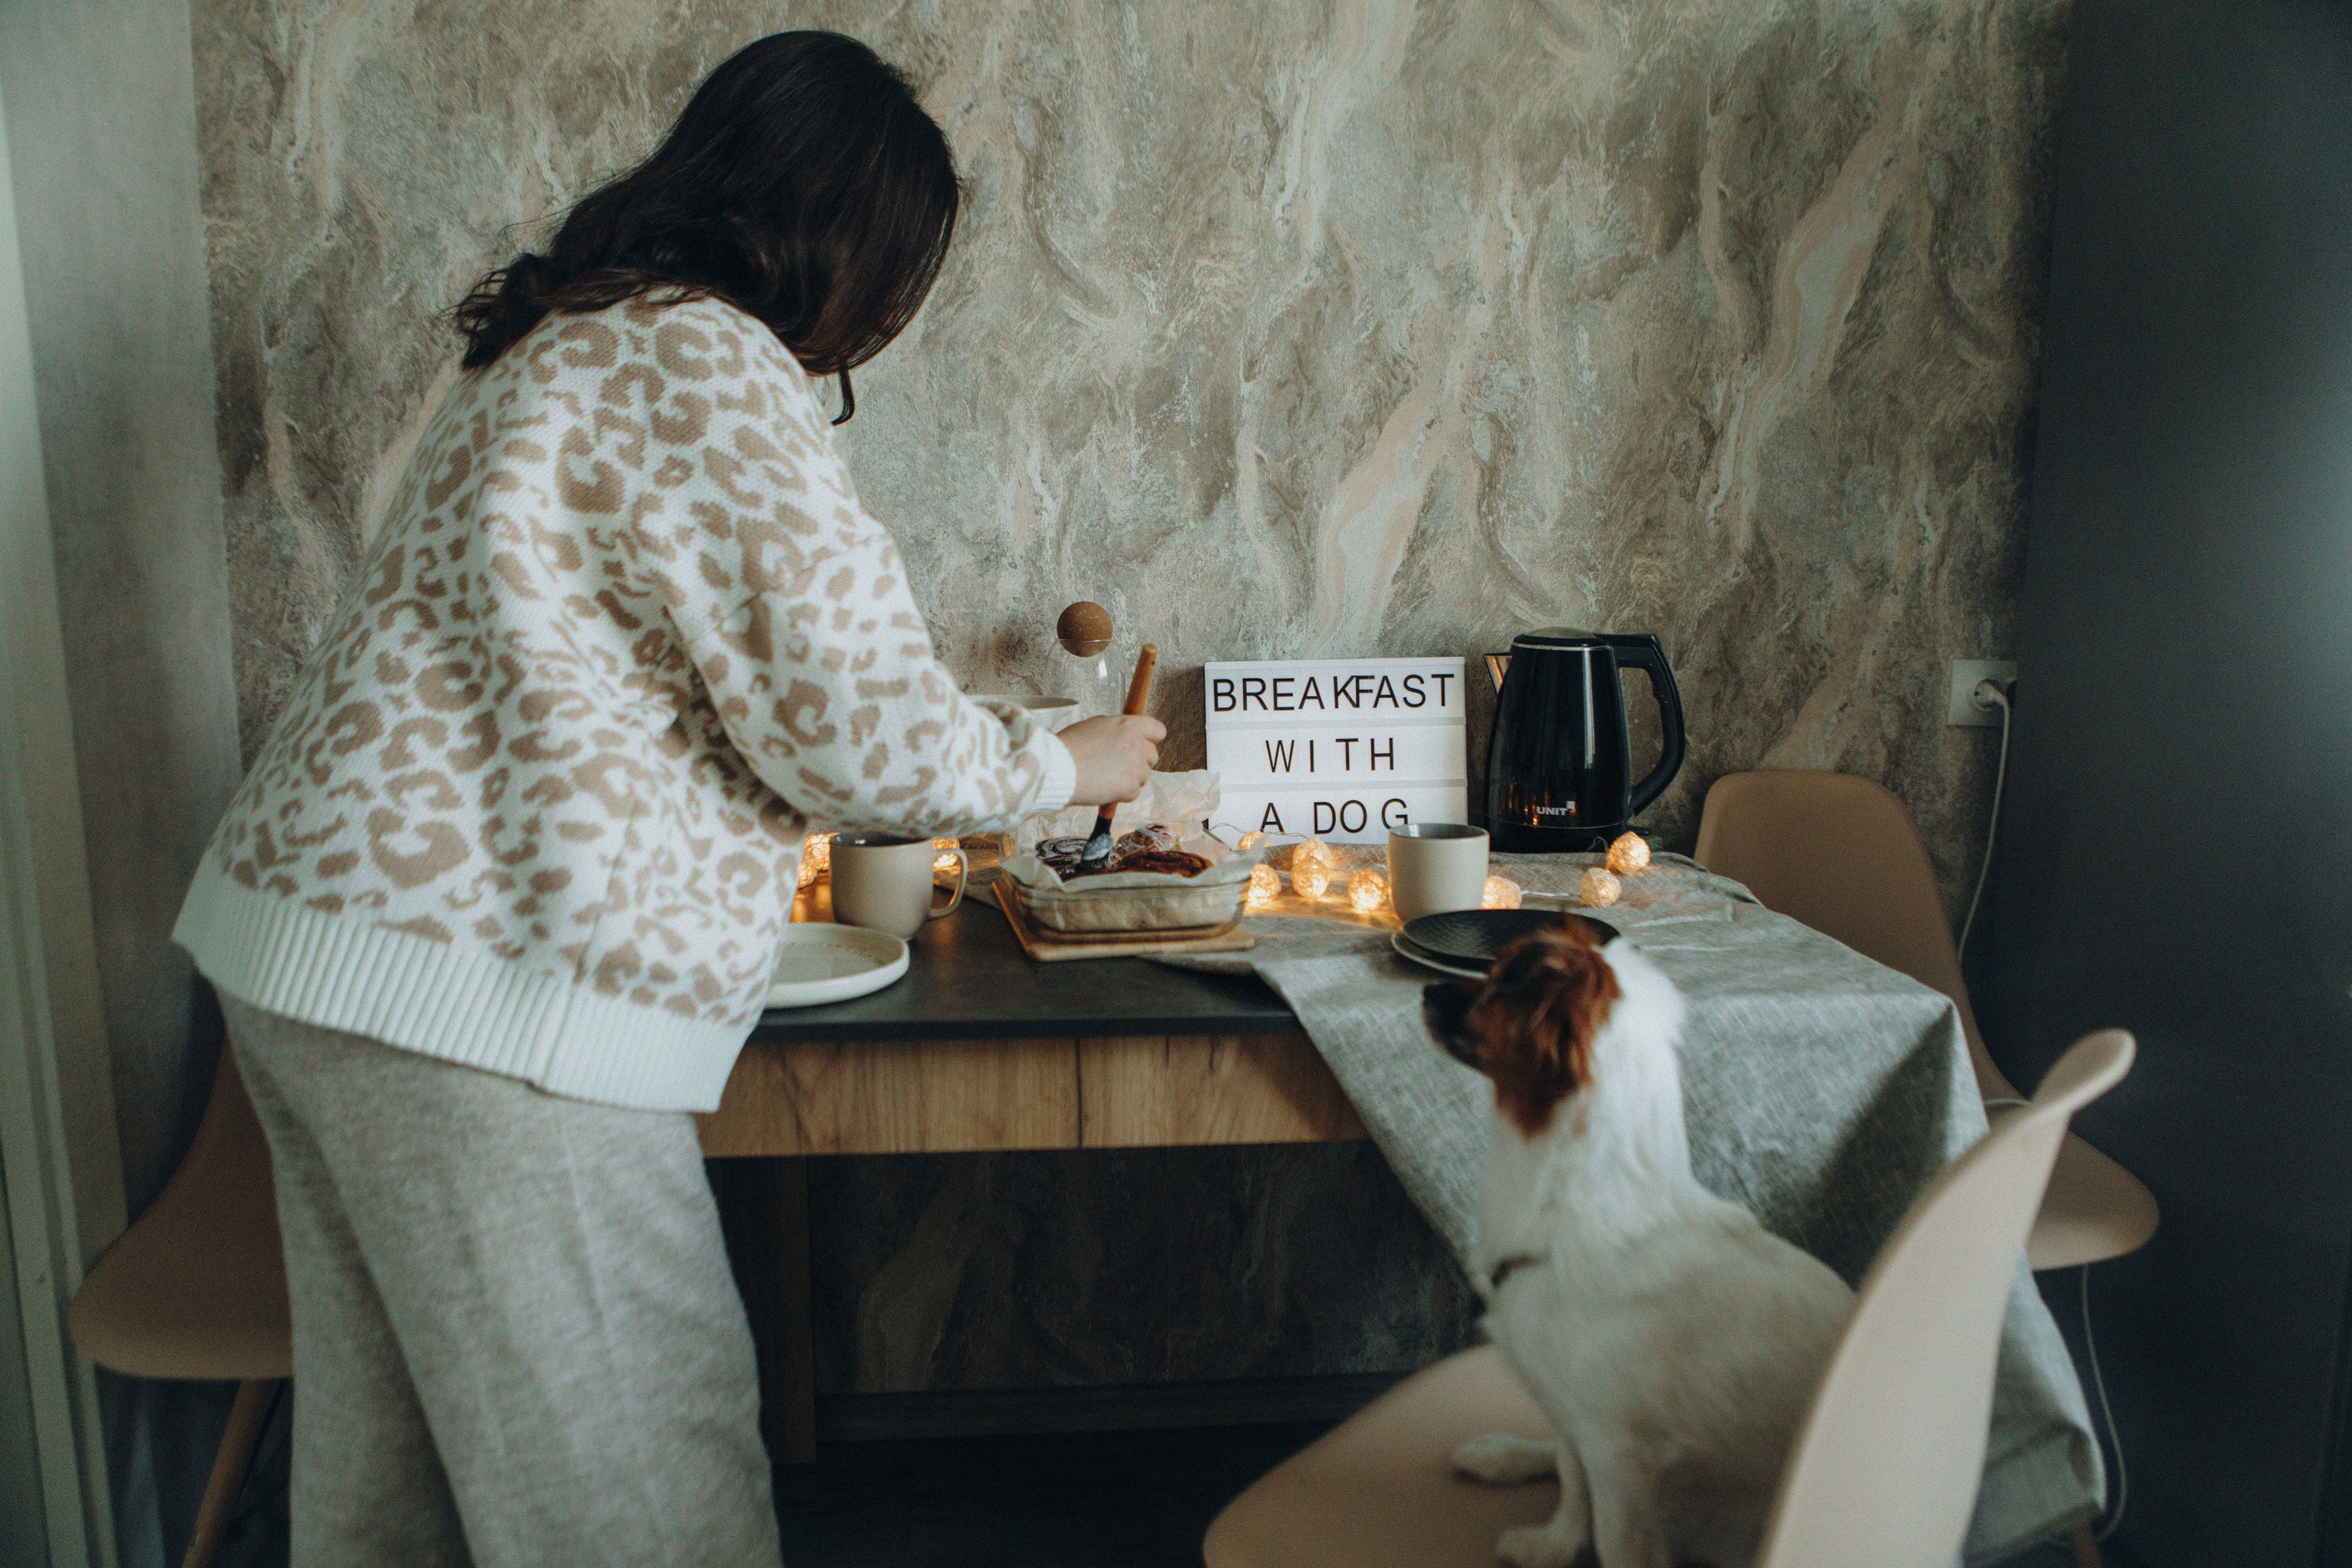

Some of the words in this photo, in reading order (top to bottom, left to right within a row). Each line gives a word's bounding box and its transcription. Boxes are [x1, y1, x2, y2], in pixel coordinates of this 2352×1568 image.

[1213, 674, 1454, 712] BREAKFAST
[1265, 738, 1394, 773] WITH
[1260, 802, 1284, 833] A
[1313, 797, 1408, 835] DOG
[1536, 807, 1567, 816] UNIT
